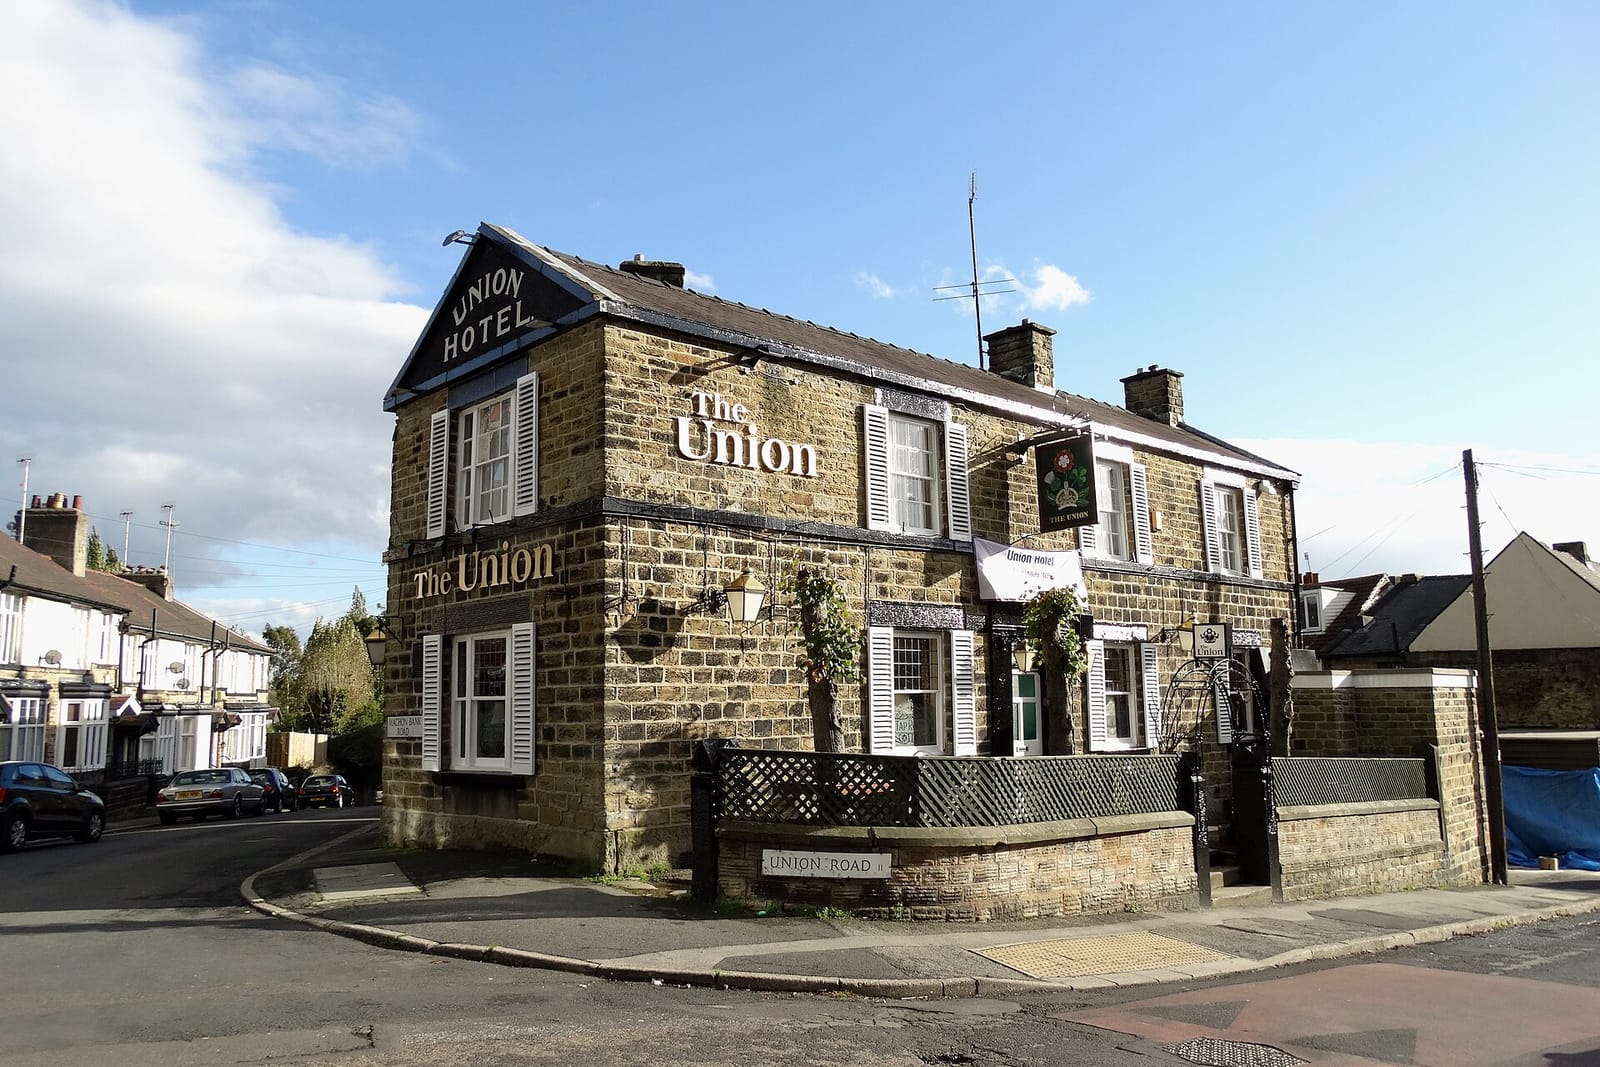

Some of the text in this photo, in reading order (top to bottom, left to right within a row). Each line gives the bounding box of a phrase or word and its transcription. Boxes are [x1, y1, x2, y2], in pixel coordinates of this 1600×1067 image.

[452, 268, 524, 327] UNION
[691, 391, 748, 423] The
[677, 416, 819, 477] Union
[1050, 511, 1089, 524] THE UNION
[1007, 550, 1032, 563] Union
[414, 540, 554, 599] The Union
[1197, 648, 1223, 656] Union
[770, 856, 821, 871] UNION
[830, 859, 871, 872] ROAD
